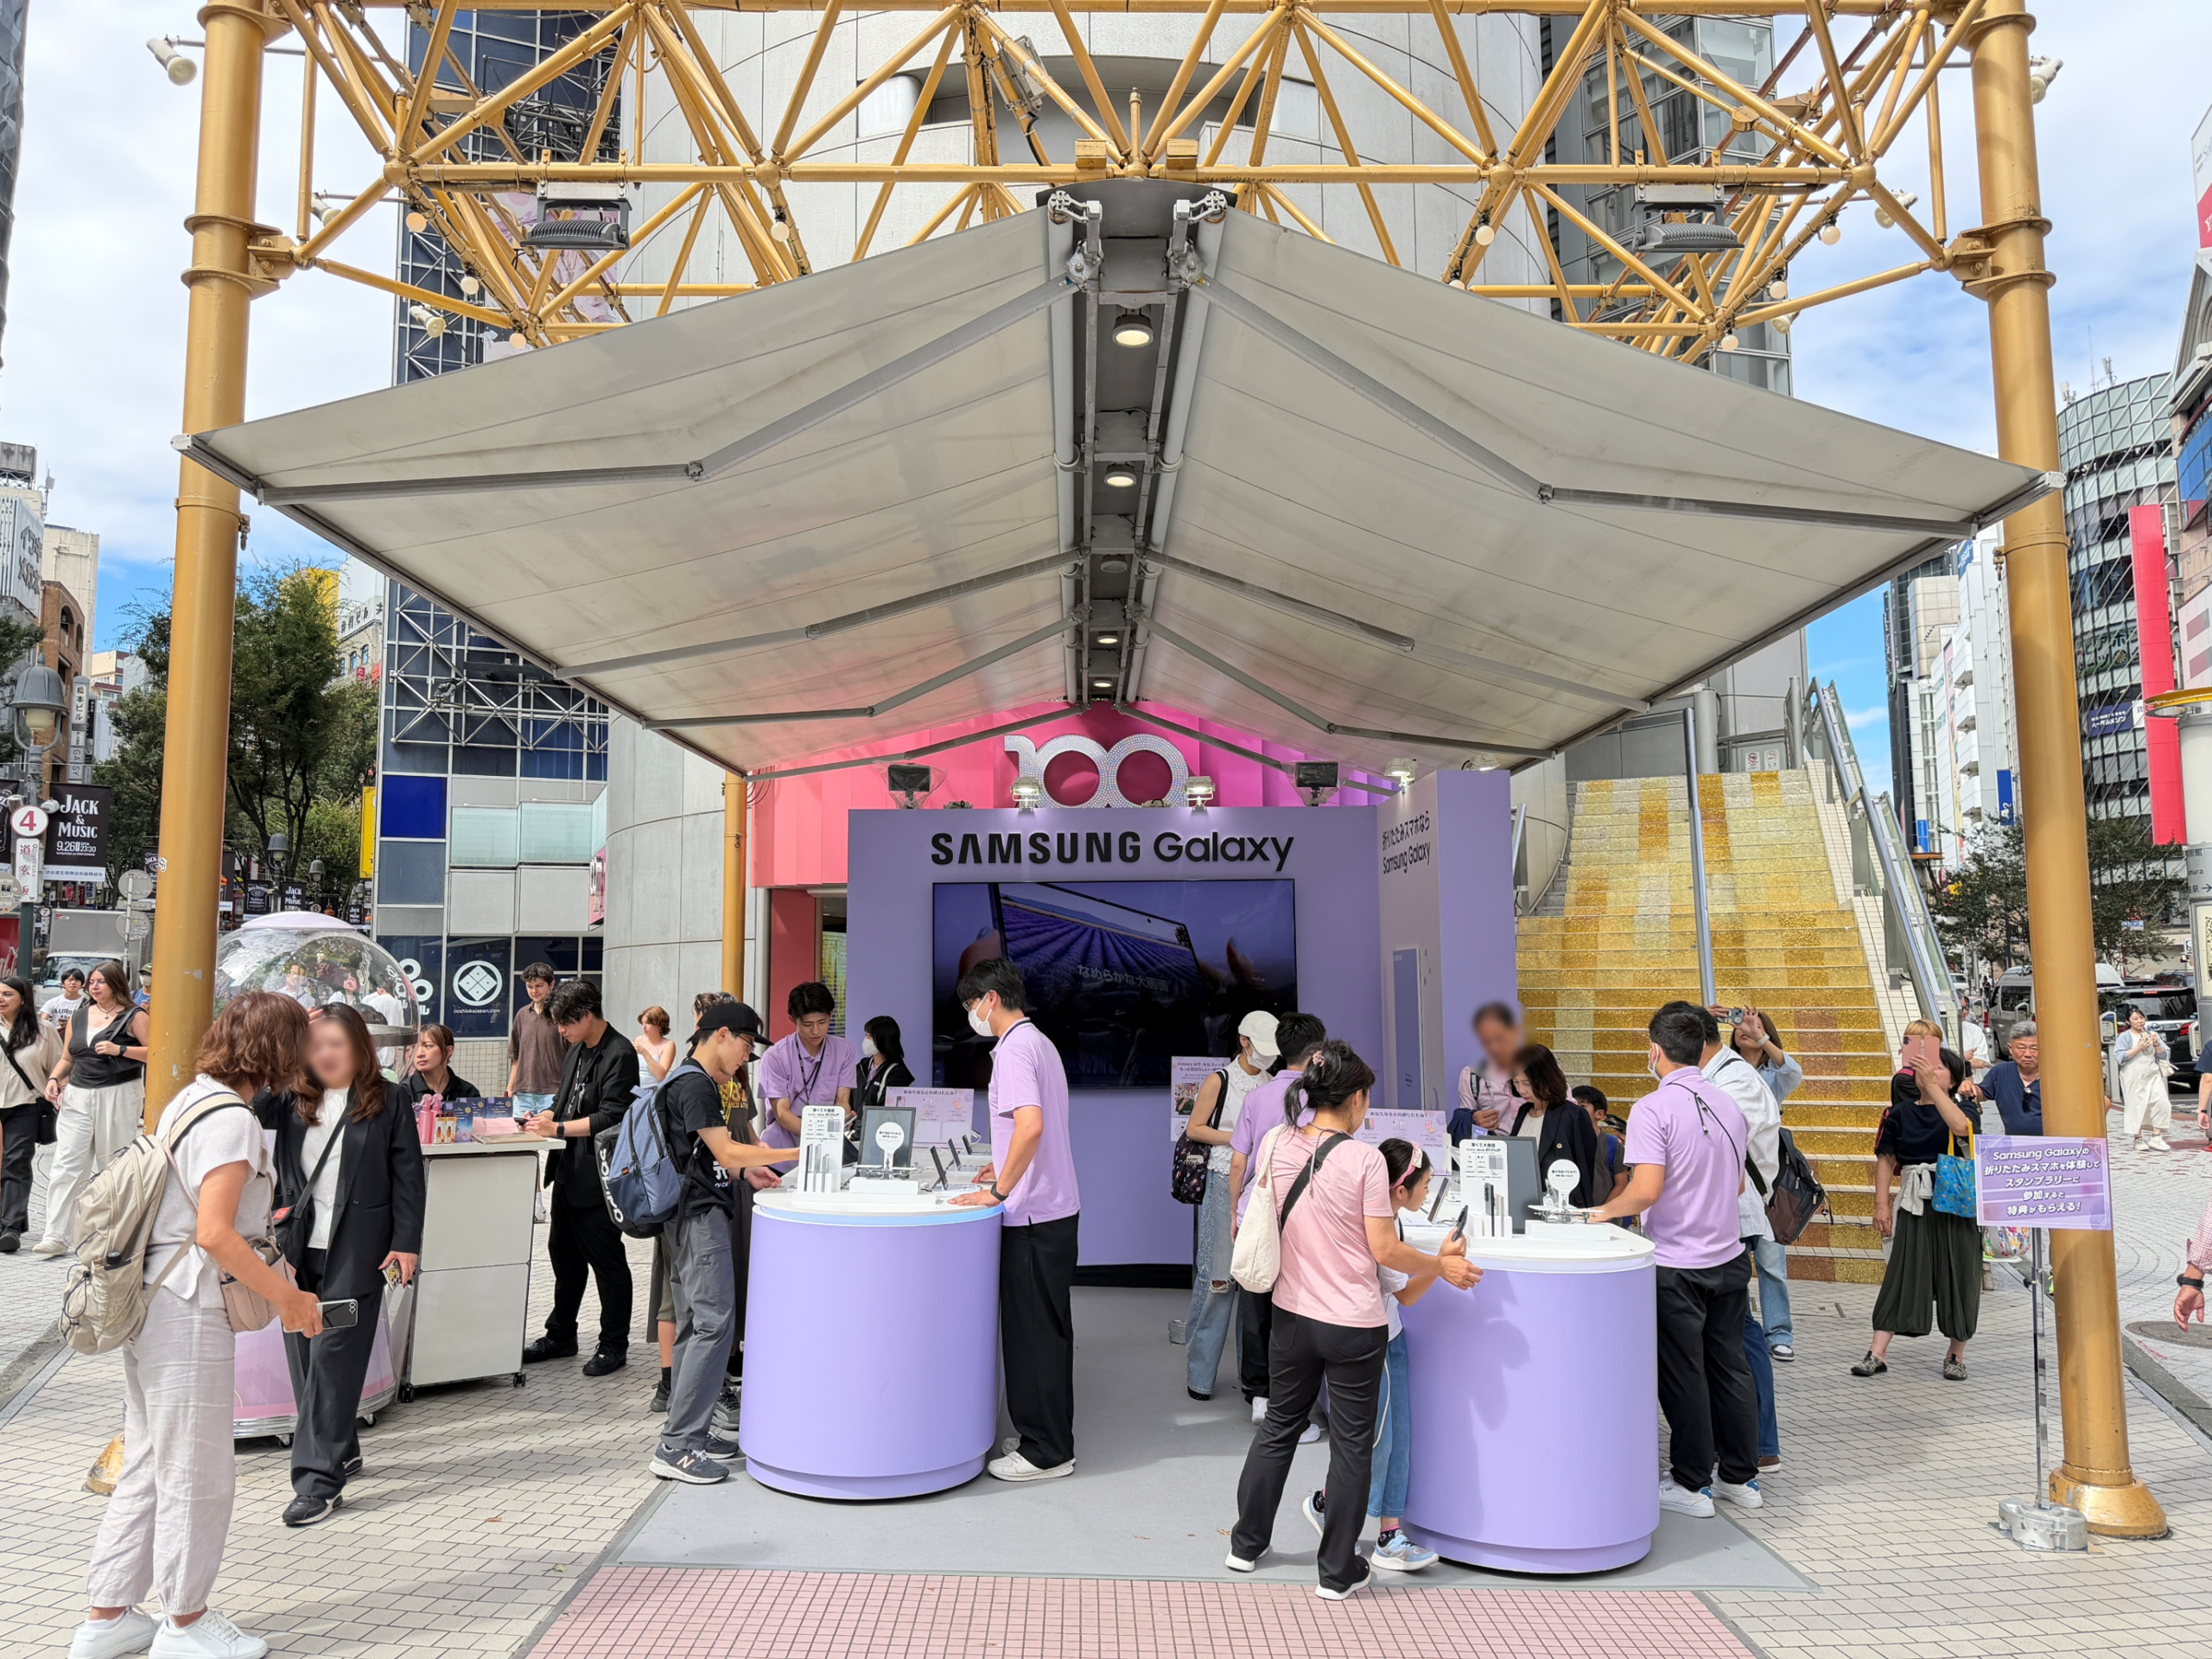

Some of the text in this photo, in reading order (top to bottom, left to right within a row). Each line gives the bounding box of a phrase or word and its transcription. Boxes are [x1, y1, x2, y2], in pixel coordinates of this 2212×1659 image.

[1004, 734, 1189, 808] 100
[60, 794, 99, 815] JACK
[19, 810, 37, 832] 4
[75, 814, 85, 825] &
[57, 822, 98, 839] MUSIC
[931, 831, 1295, 872] SAMSUNG Galaxy
[1382, 841, 1431, 874] Samsung Galaxy
[285, 886, 302, 895] JACK
[1077, 963, 1169, 992] なめらかな大画面
[1993, 1147, 2089, 1161] Samsung Galaxyの
[1984, 1160, 2101, 1176] 折りたたみスマホを体験して
[2005, 1175, 2080, 1188] スタンプラリーに
[2023, 1190, 2066, 1201] 参加すると
[2006, 1202, 2082, 1217] 特典がもらえる!
